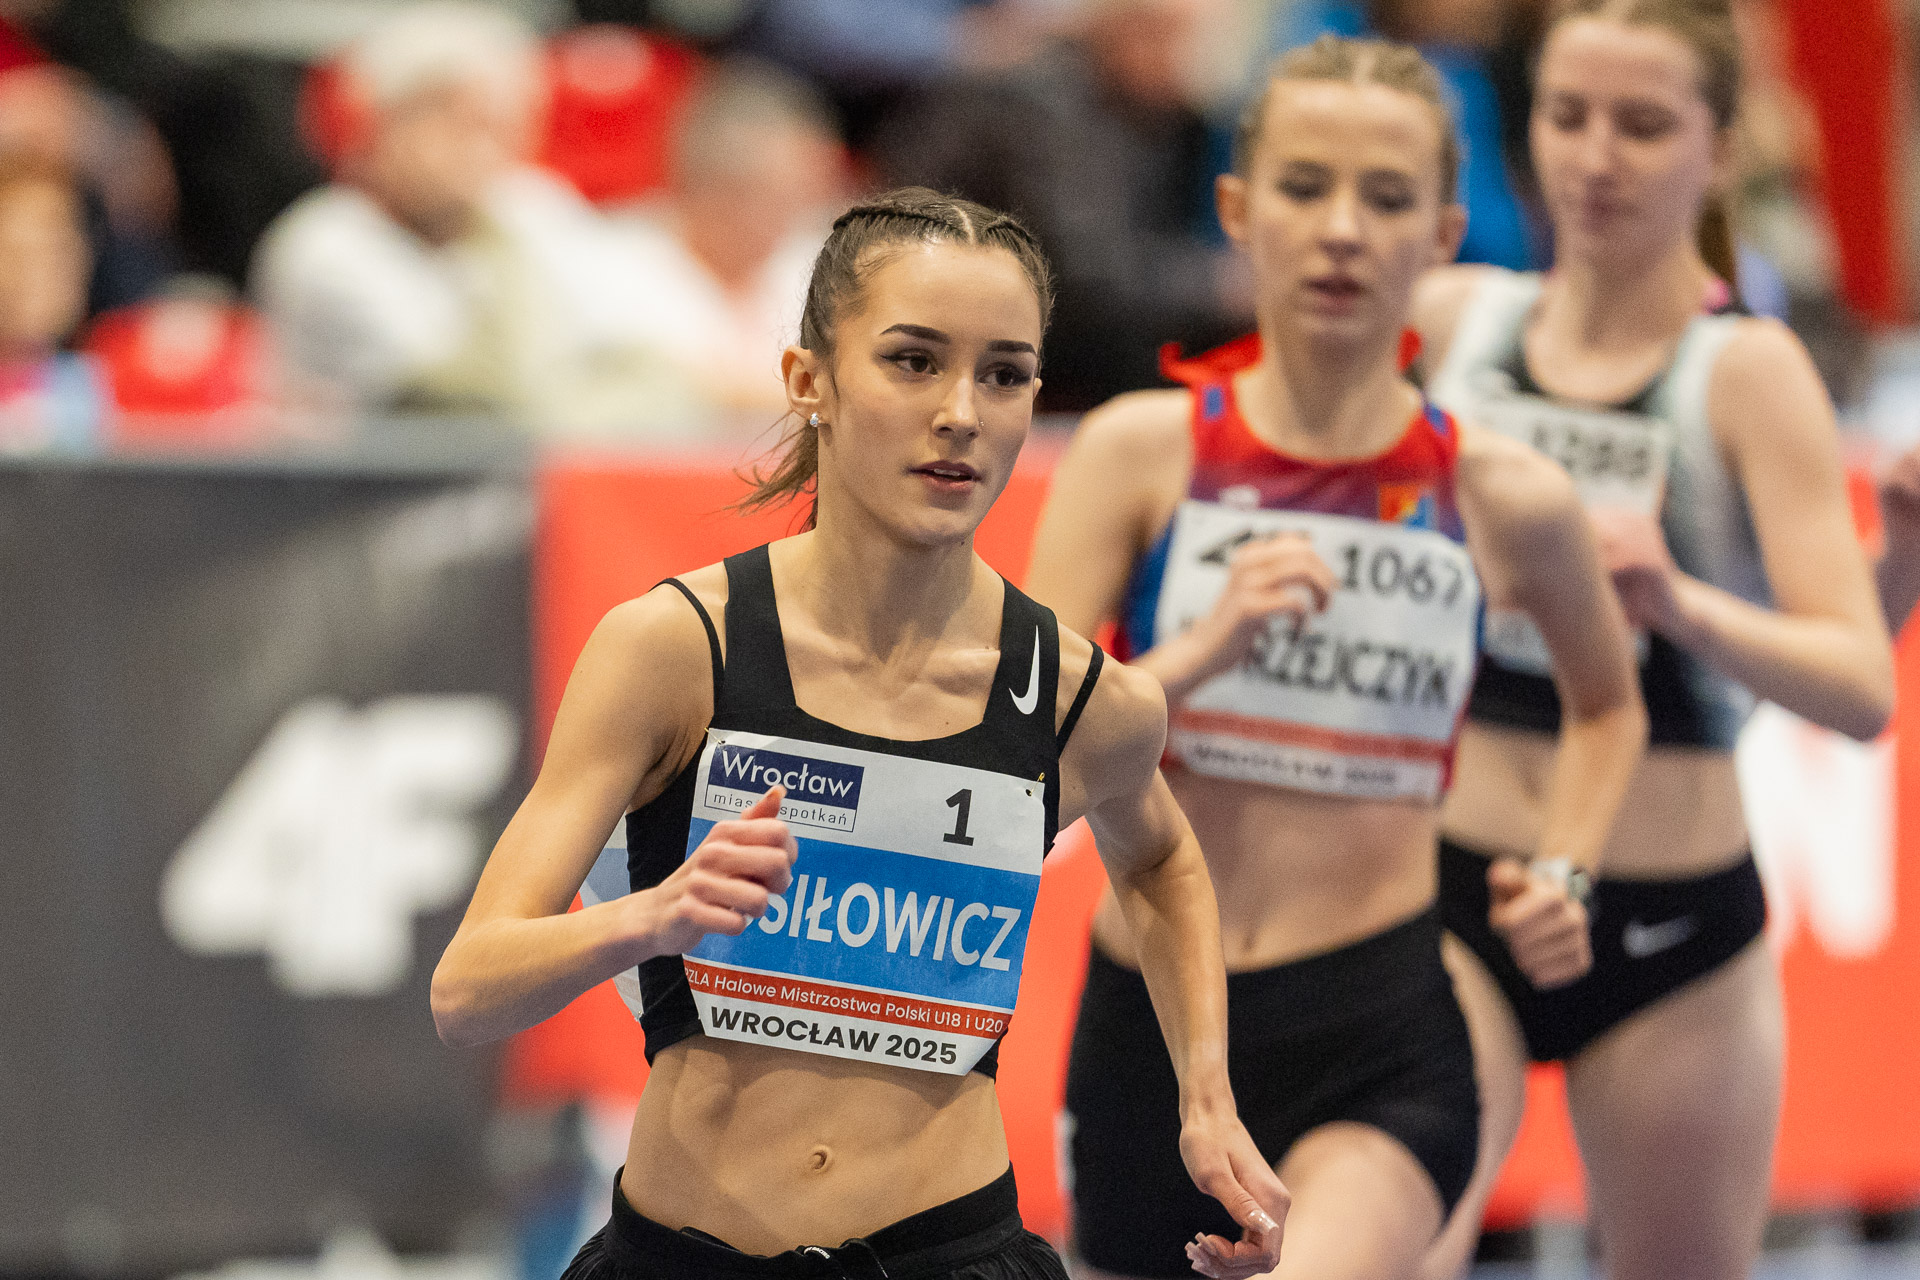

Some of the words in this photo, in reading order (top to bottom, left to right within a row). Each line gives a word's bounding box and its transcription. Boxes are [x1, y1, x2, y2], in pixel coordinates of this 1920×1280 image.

[1342, 543, 1463, 608] 1067
[722, 749, 854, 799] Wrocław
[713, 793, 762, 809] mias
[779, 804, 848, 826] spotkań
[942, 788, 975, 846] 1
[163, 696, 518, 996] 4F
[746, 873, 1022, 972] SIŁOWICZ
[714, 975, 777, 998] Halowe
[780, 986, 881, 1014] Mistrzostwa
[885, 1002, 931, 1022] Polski
[934, 1010, 961, 1028] U18
[965, 1014, 971, 1029] i
[974, 1017, 1004, 1033] U20
[711, 1006, 880, 1053] WROCŁAW
[884, 1034, 957, 1065] 2025
